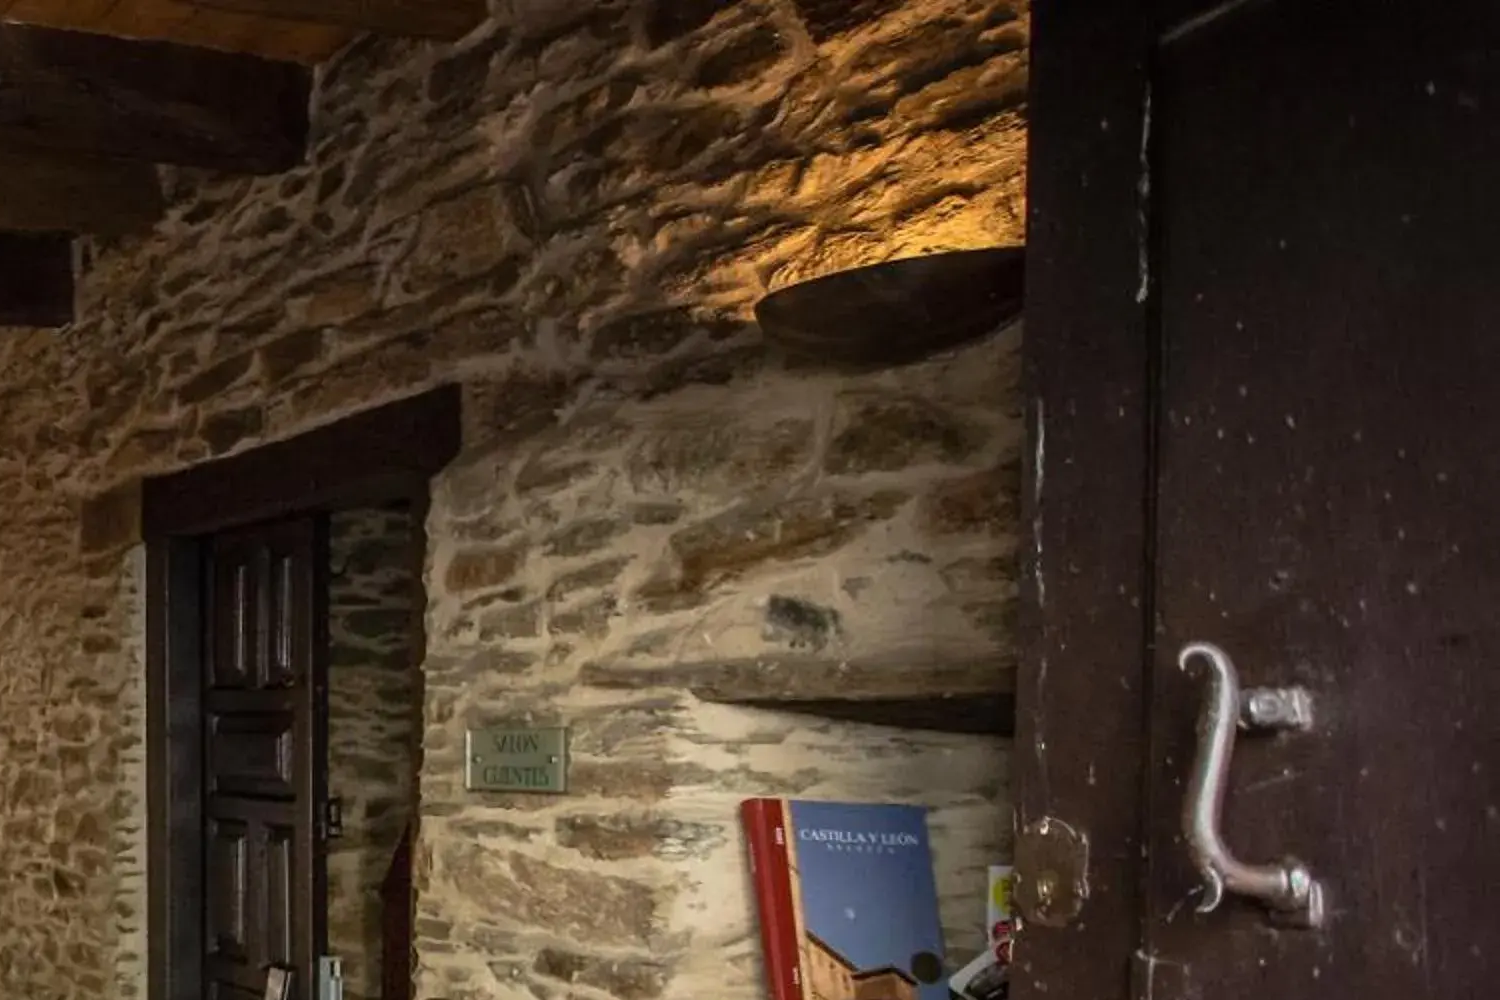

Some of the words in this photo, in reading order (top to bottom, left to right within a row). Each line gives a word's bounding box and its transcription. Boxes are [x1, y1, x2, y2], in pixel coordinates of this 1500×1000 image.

[800, 828, 867, 844] CASTILLA
[868, 832, 879, 844] Y
[881, 831, 919, 846] LEÓN
